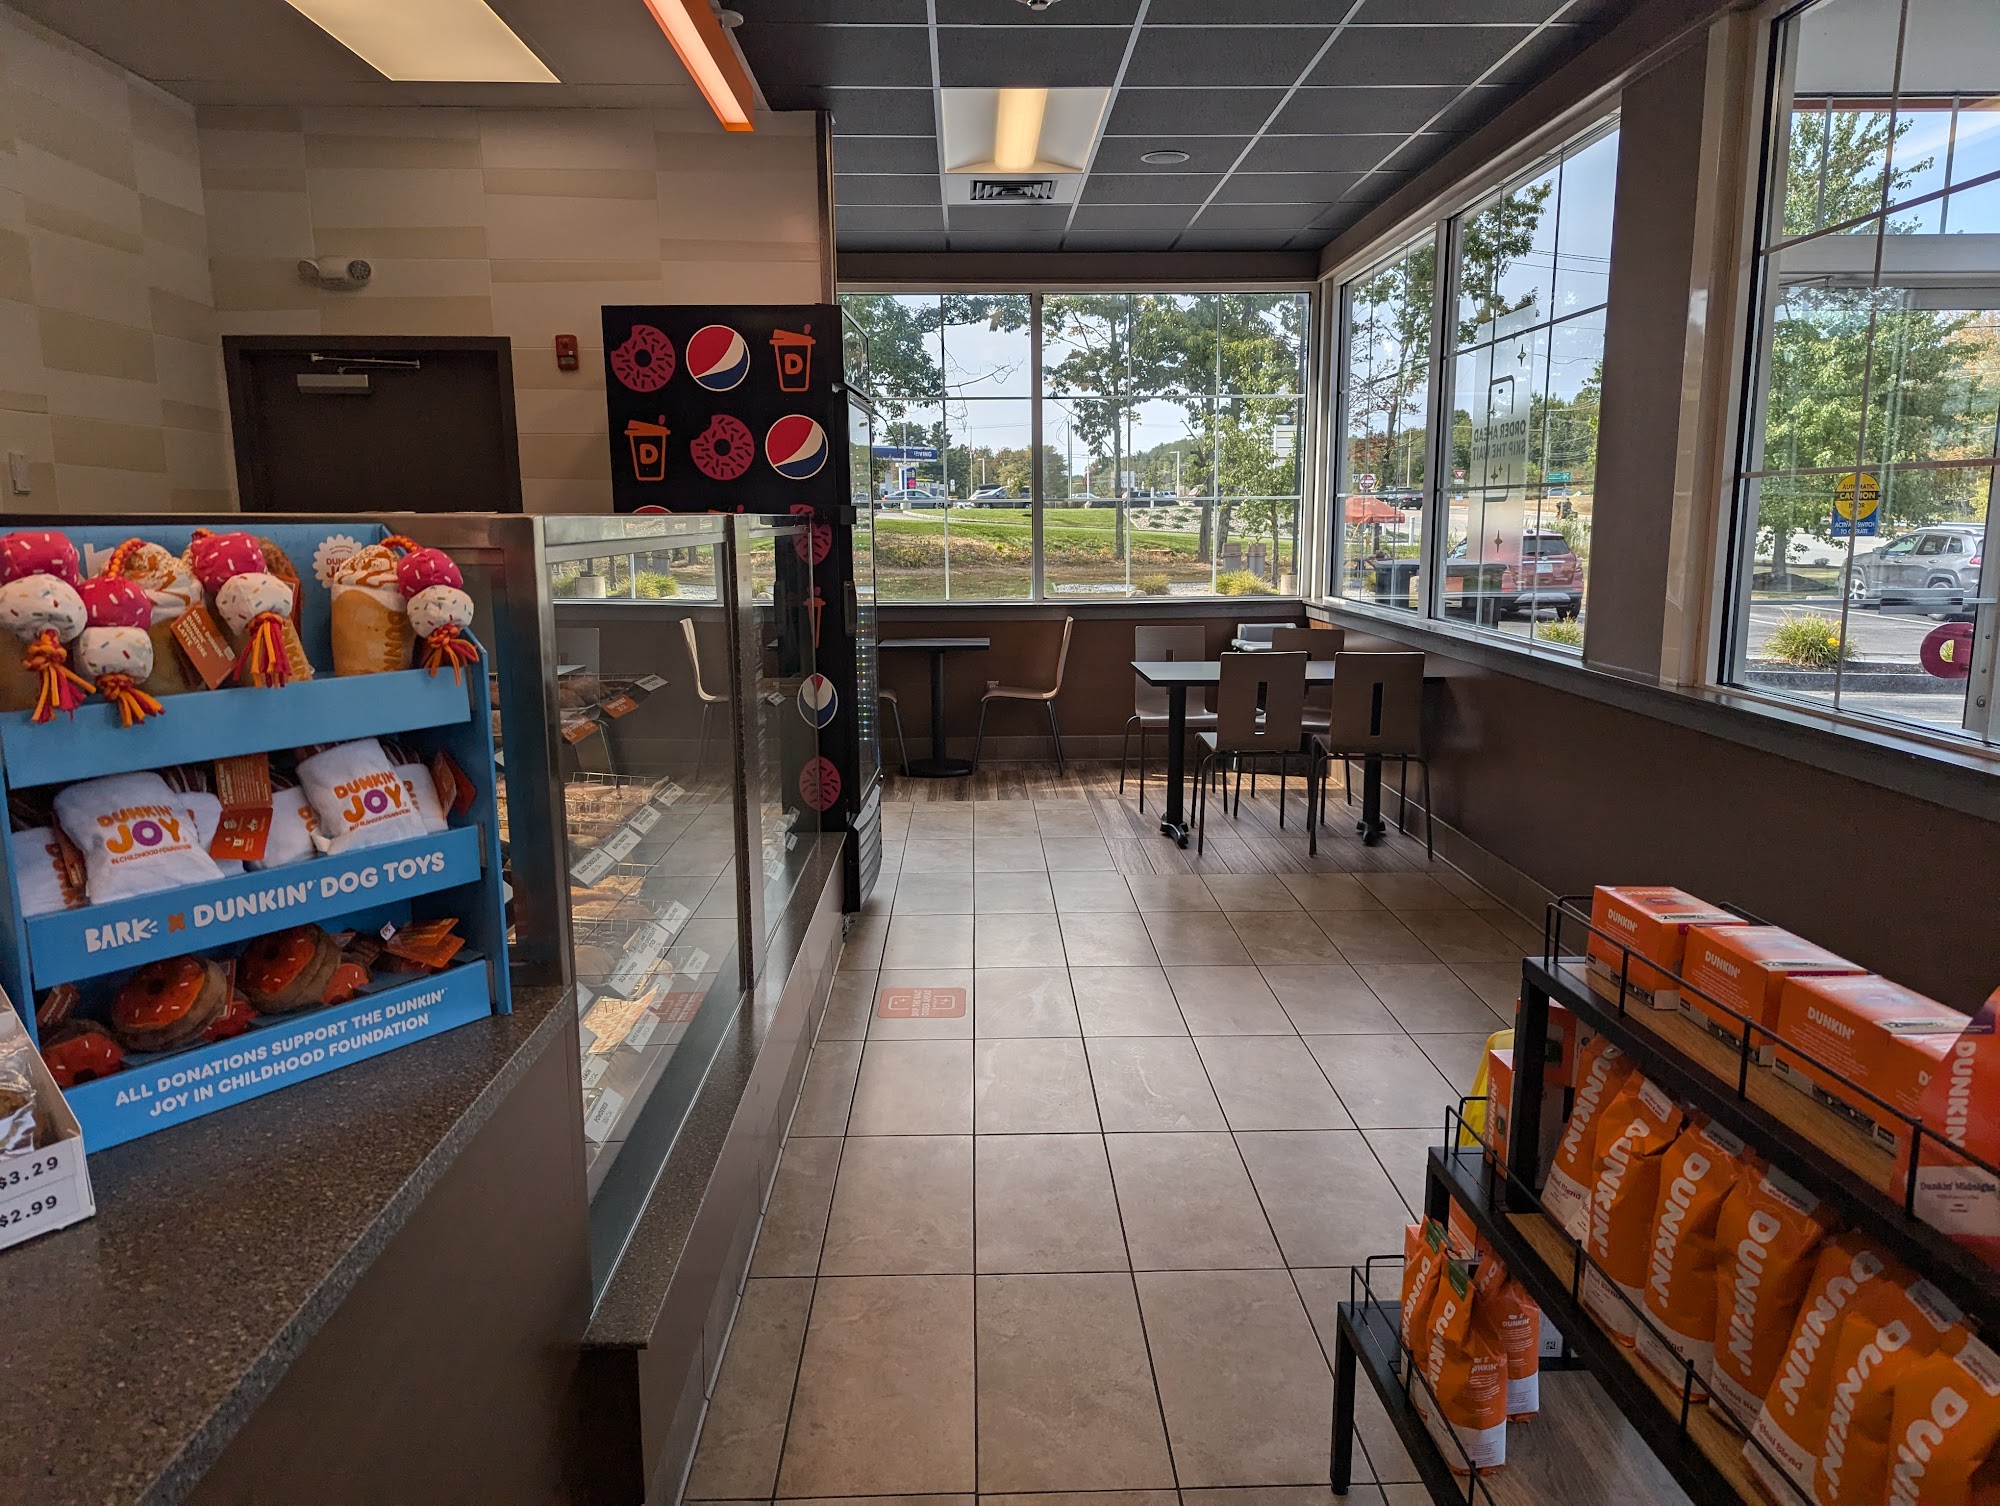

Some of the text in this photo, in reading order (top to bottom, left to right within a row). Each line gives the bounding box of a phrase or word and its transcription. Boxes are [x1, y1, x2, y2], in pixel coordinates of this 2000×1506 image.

[785, 353, 803, 375] D
[639, 443, 658, 465] D
[1839, 491, 1876, 500] CAUION
[177, 625, 193, 648] LATTE
[333, 771, 396, 800] DUNKIN'
[97, 804, 172, 828] DUNKIN'
[343, 783, 403, 823] JOY
[106, 818, 180, 854] JOY
[85, 918, 155, 953] BARK
[194, 880, 313, 928] DUNKIN'
[320, 867, 378, 898] DOG
[383, 852, 445, 883] TOYS
[1607, 908, 1638, 933] DUNKIN'
[1705, 950, 1741, 979] DUNKIN'
[1807, 1007, 1855, 1040] DUNKIN'
[115, 988, 446, 1106] ALL DONATIONS SUPPORT THE DUNKIN'
[150, 1014, 429, 1117] JOY IN CHILDHOOD FOUNDATION
[0, 1156, 59, 1190] $3.29
[1593, 1118, 1650, 1258] DUNKIN'
[1920, 1181, 1954, 1191] Dunkin'
[1560, 1182, 1581, 1201] Blend
[0, 1195, 57, 1228] $2.99
[1651, 1152, 1711, 1308] DUNKIN'
[1728, 1210, 1781, 1376] DUNKIN'
[1502, 1318, 1531, 1327] DUNKIN'
[1779, 1251, 1884, 1416] DUNKIN'
[1822, 1320, 1911, 1500] DUNKIN'
[1775, 1442, 1803, 1471] Blend
